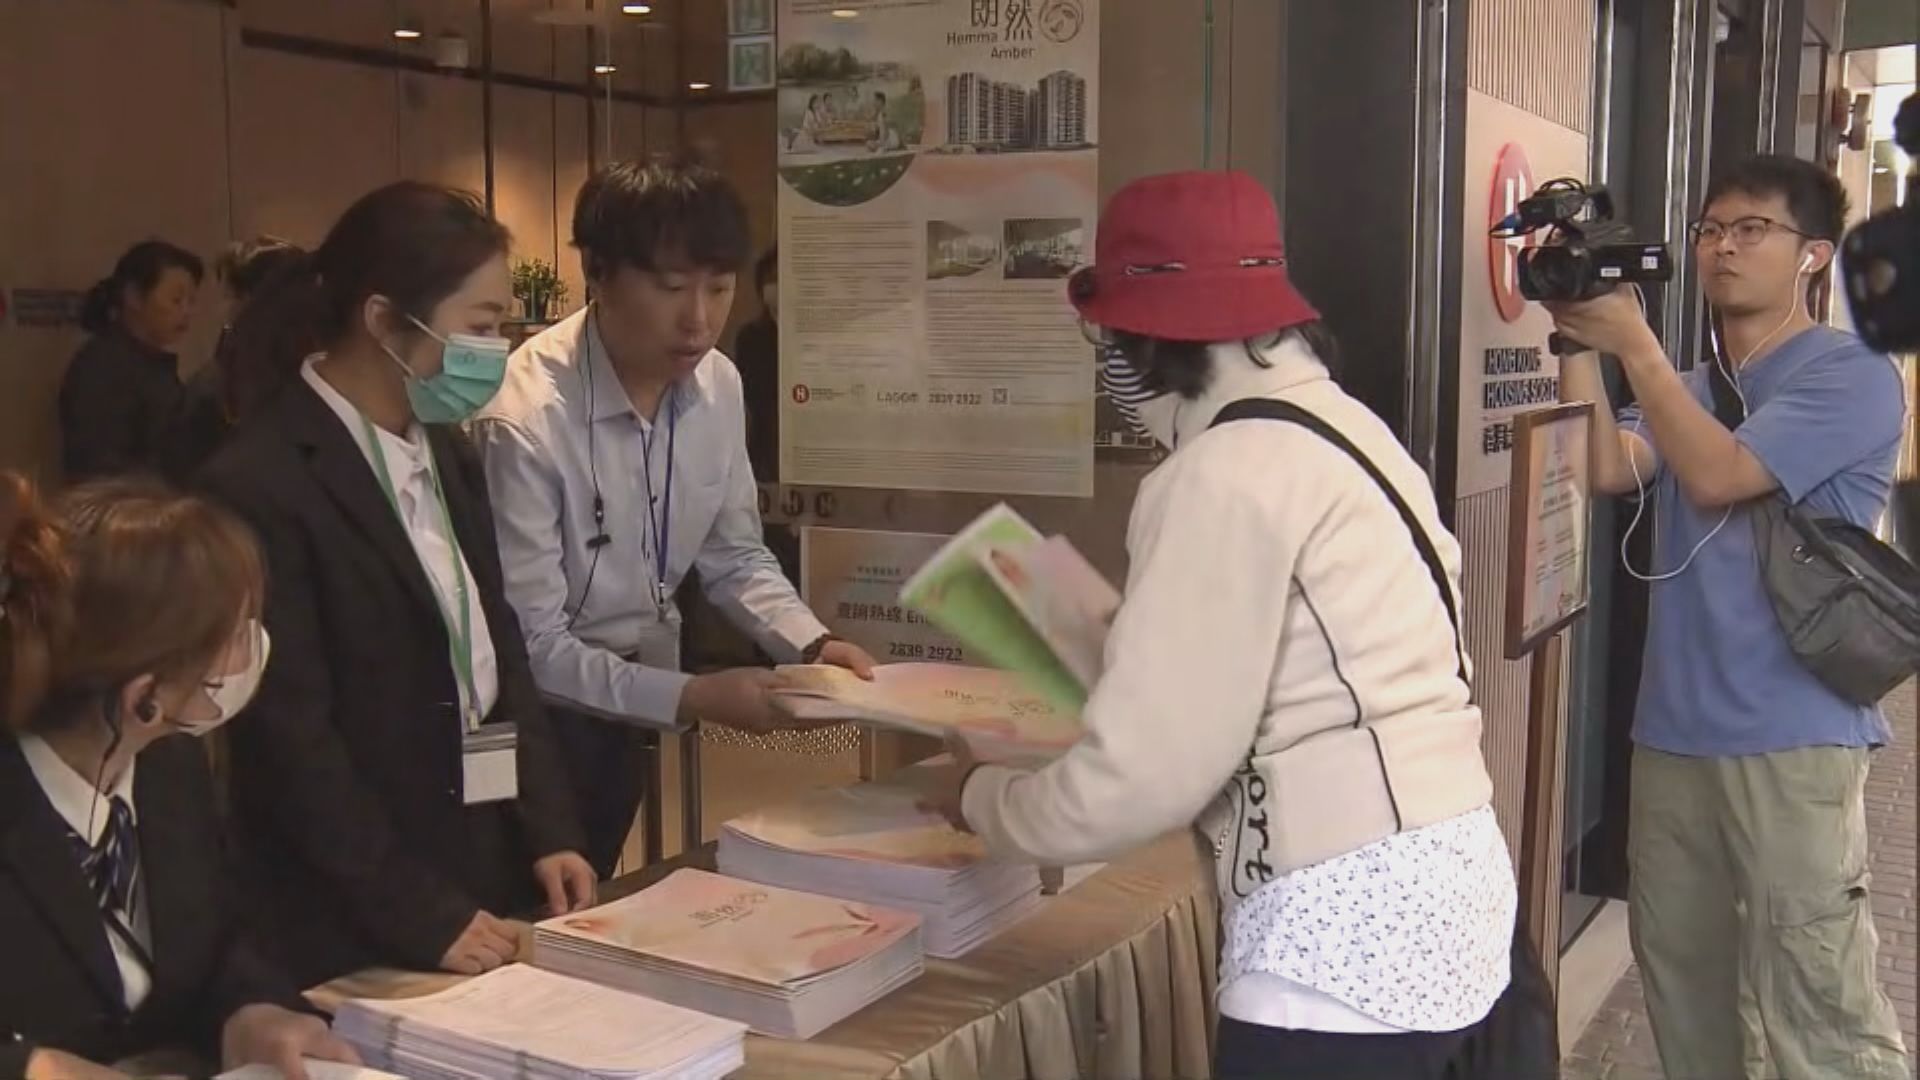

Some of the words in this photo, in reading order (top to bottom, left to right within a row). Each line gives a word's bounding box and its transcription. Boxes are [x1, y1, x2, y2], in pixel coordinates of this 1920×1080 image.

[971, 0, 1033, 41] 朗然
[946, 31, 998, 45] Hemma
[991, 47, 1033, 59] Amber
[1484, 348, 1515, 375] HONG
[1515, 347, 1542, 373] KONG
[889, 642, 924, 657] 2839
[927, 646, 963, 662] 2922
